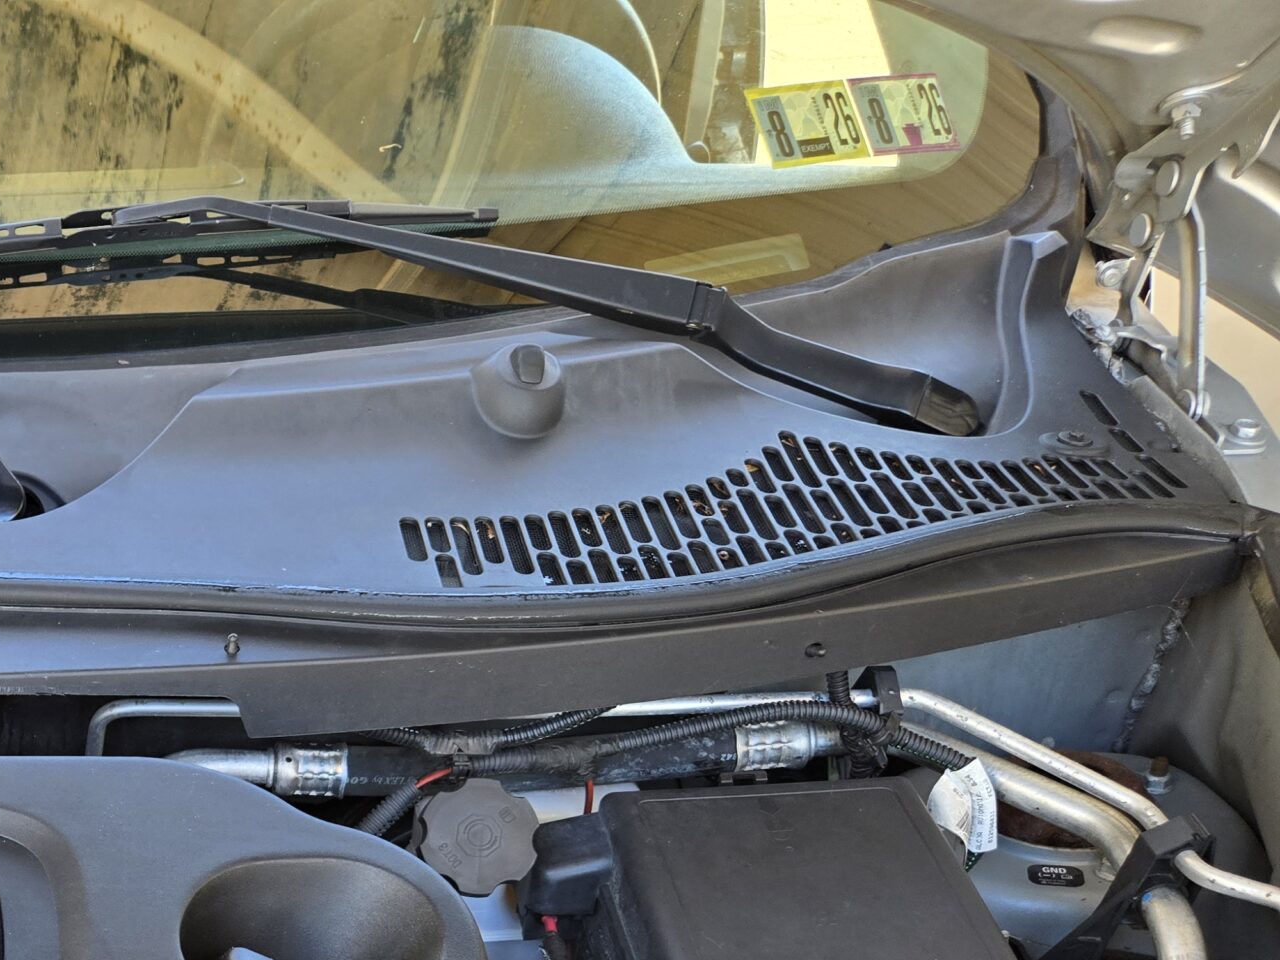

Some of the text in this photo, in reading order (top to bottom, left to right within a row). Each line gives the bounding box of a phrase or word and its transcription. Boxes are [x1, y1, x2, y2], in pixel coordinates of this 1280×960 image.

[767, 110, 795, 157] 8
[822, 91, 862, 147] 26
[867, 98, 893, 145] 8
[917, 83, 952, 136] 26
[800, 142, 831, 153] EXEMPT
[1041, 866, 1067, 874] GND
